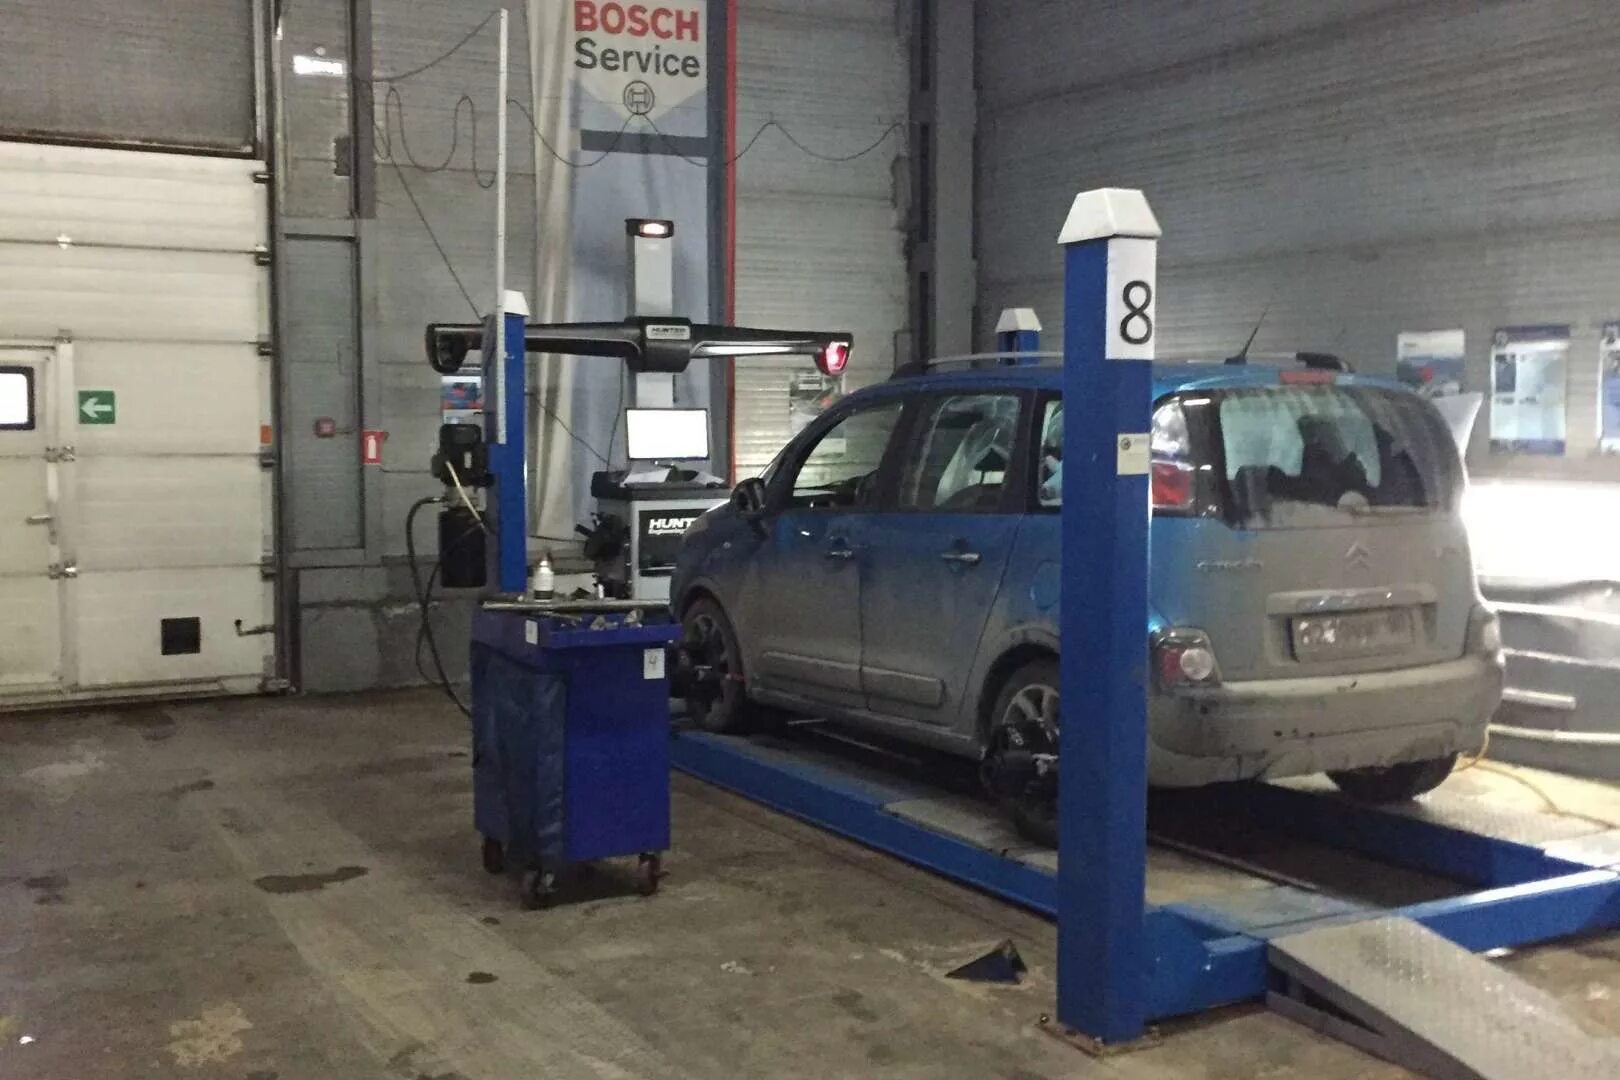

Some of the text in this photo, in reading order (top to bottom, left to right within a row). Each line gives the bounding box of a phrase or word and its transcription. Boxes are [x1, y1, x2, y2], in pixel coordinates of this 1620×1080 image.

[574, 0, 699, 42] BOSCH
[575, 37, 700, 78] Service
[1120, 280, 1152, 345] 8
[649, 517, 697, 529] HUNT
